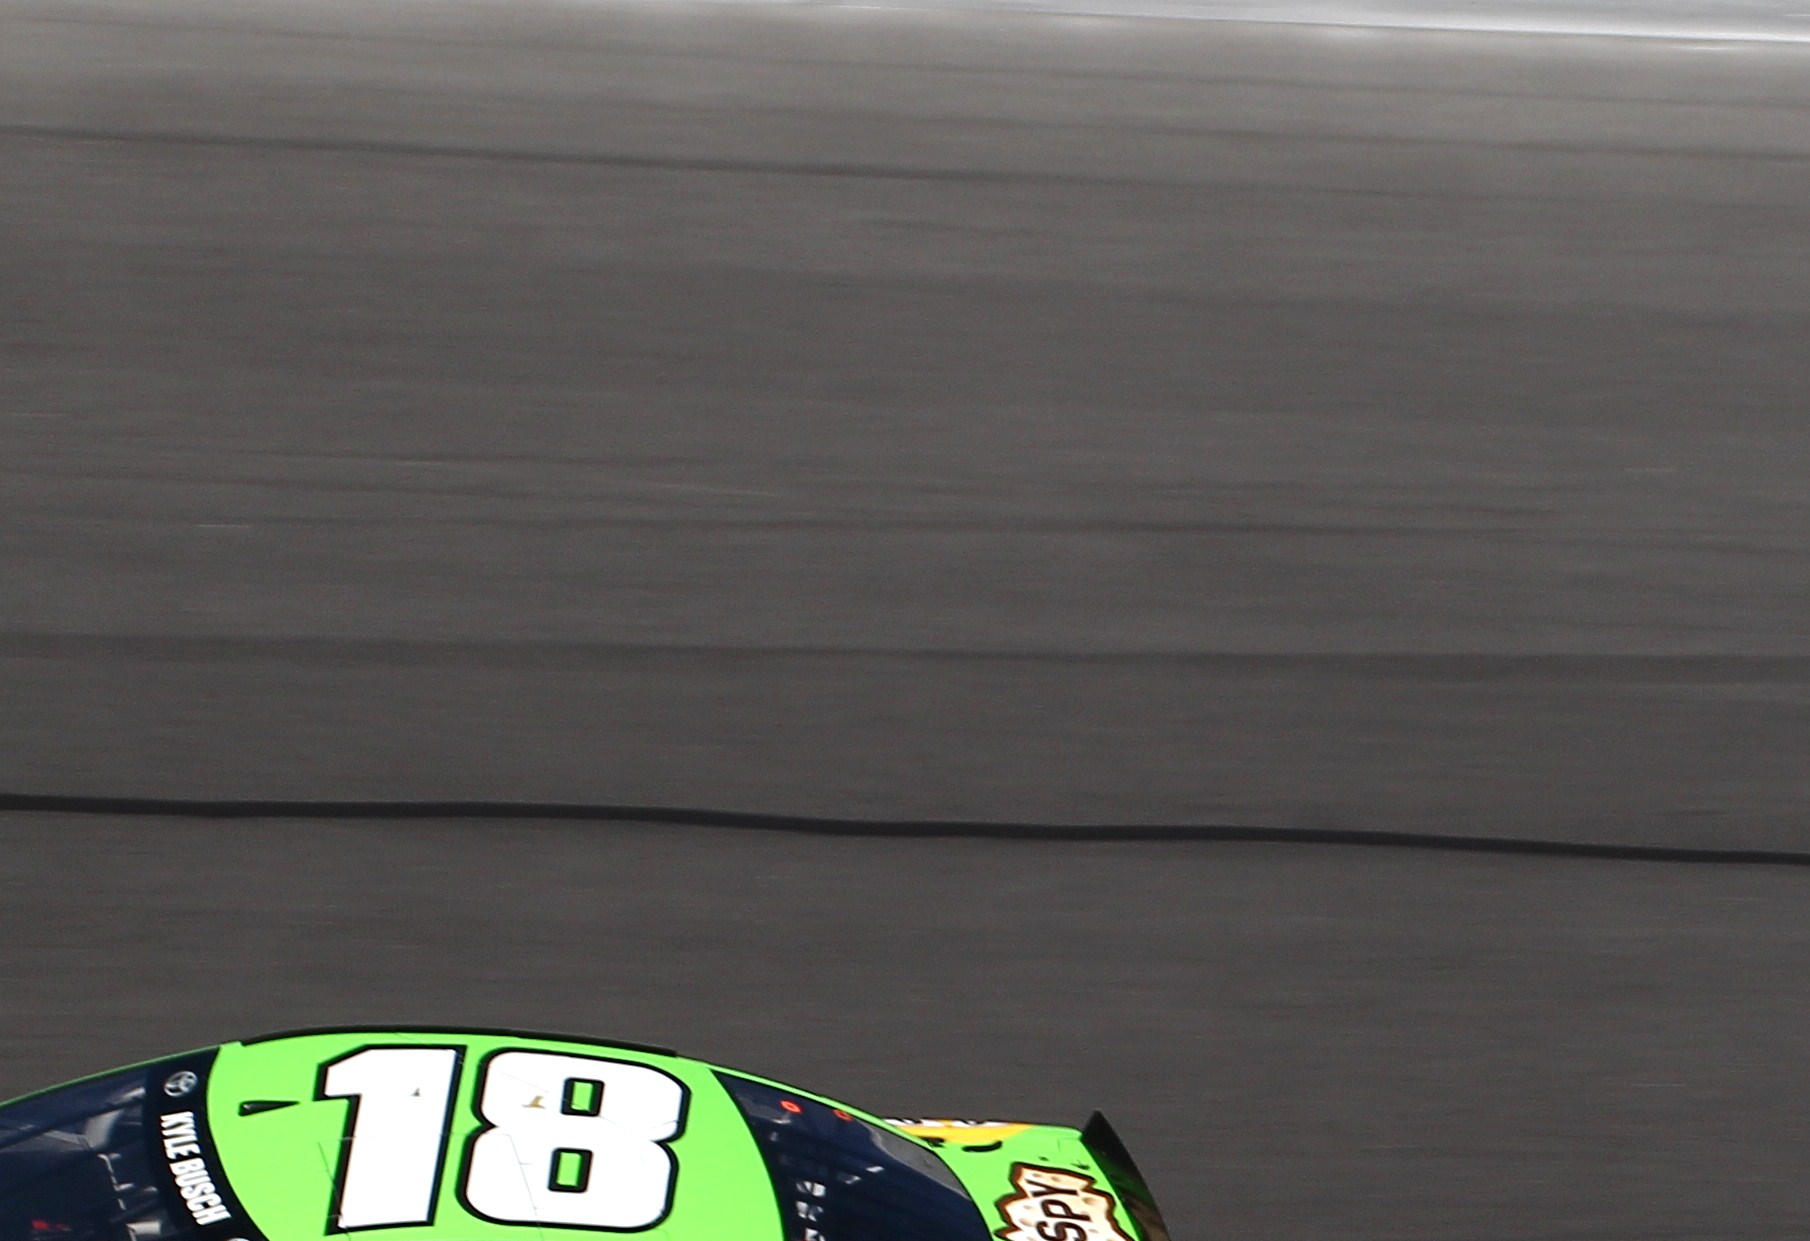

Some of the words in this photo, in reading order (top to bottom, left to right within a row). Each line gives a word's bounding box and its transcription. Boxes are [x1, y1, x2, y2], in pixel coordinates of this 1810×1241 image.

[160, 1111, 201, 1159] KYLE
[313, 1044, 691, 1235] 18
[169, 1157, 231, 1225] BUSCH
